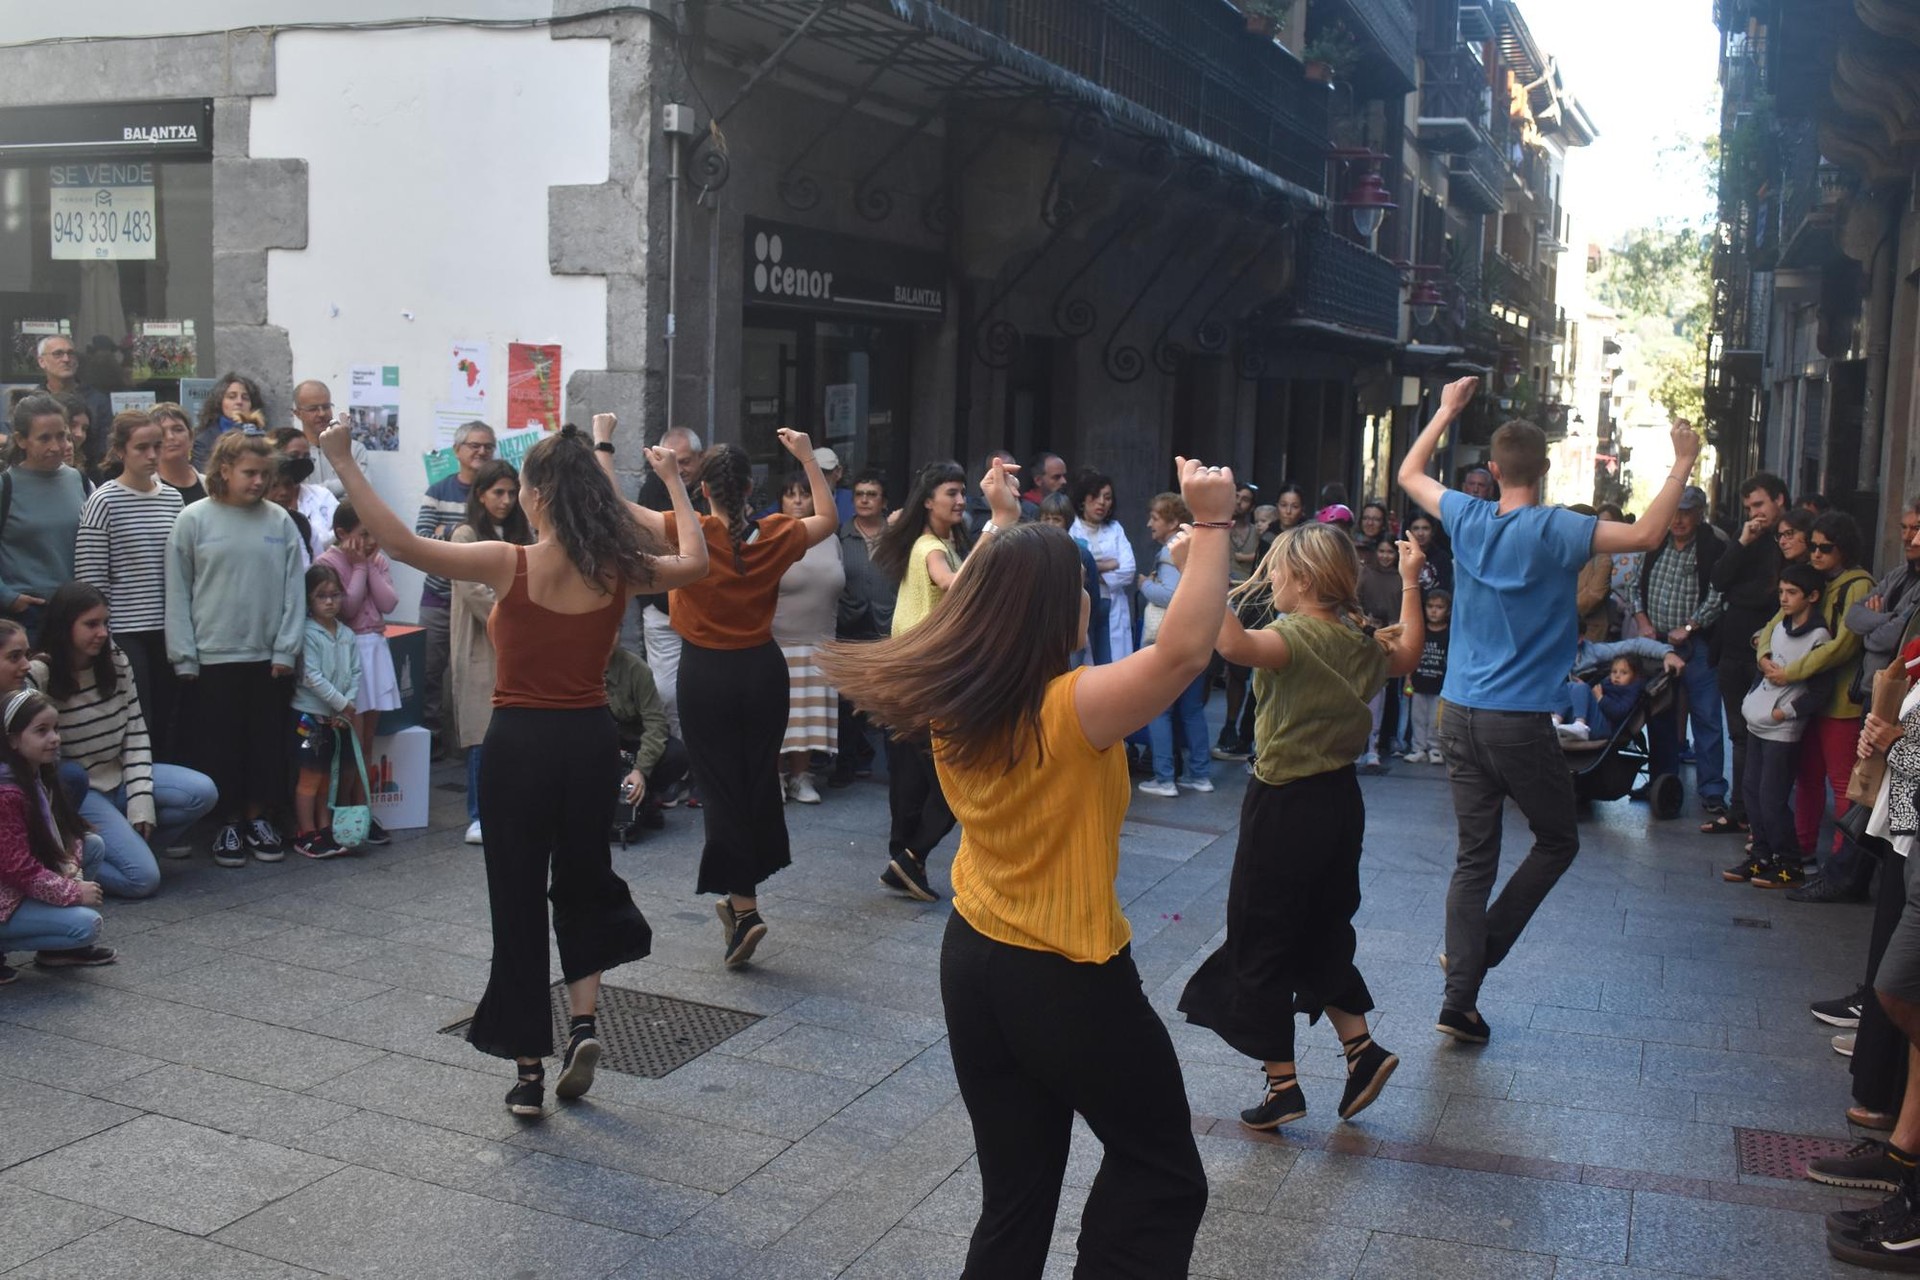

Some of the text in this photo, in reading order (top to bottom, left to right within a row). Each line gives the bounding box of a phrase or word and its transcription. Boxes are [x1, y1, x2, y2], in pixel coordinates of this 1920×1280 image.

[123, 125, 197, 140] BALANTXA
[51, 163, 153, 185] SE VENDE
[54, 210, 152, 243] 943 330 483
[770, 265, 942, 306] cenor BALANTXA
[371, 790, 403, 803] ernani
